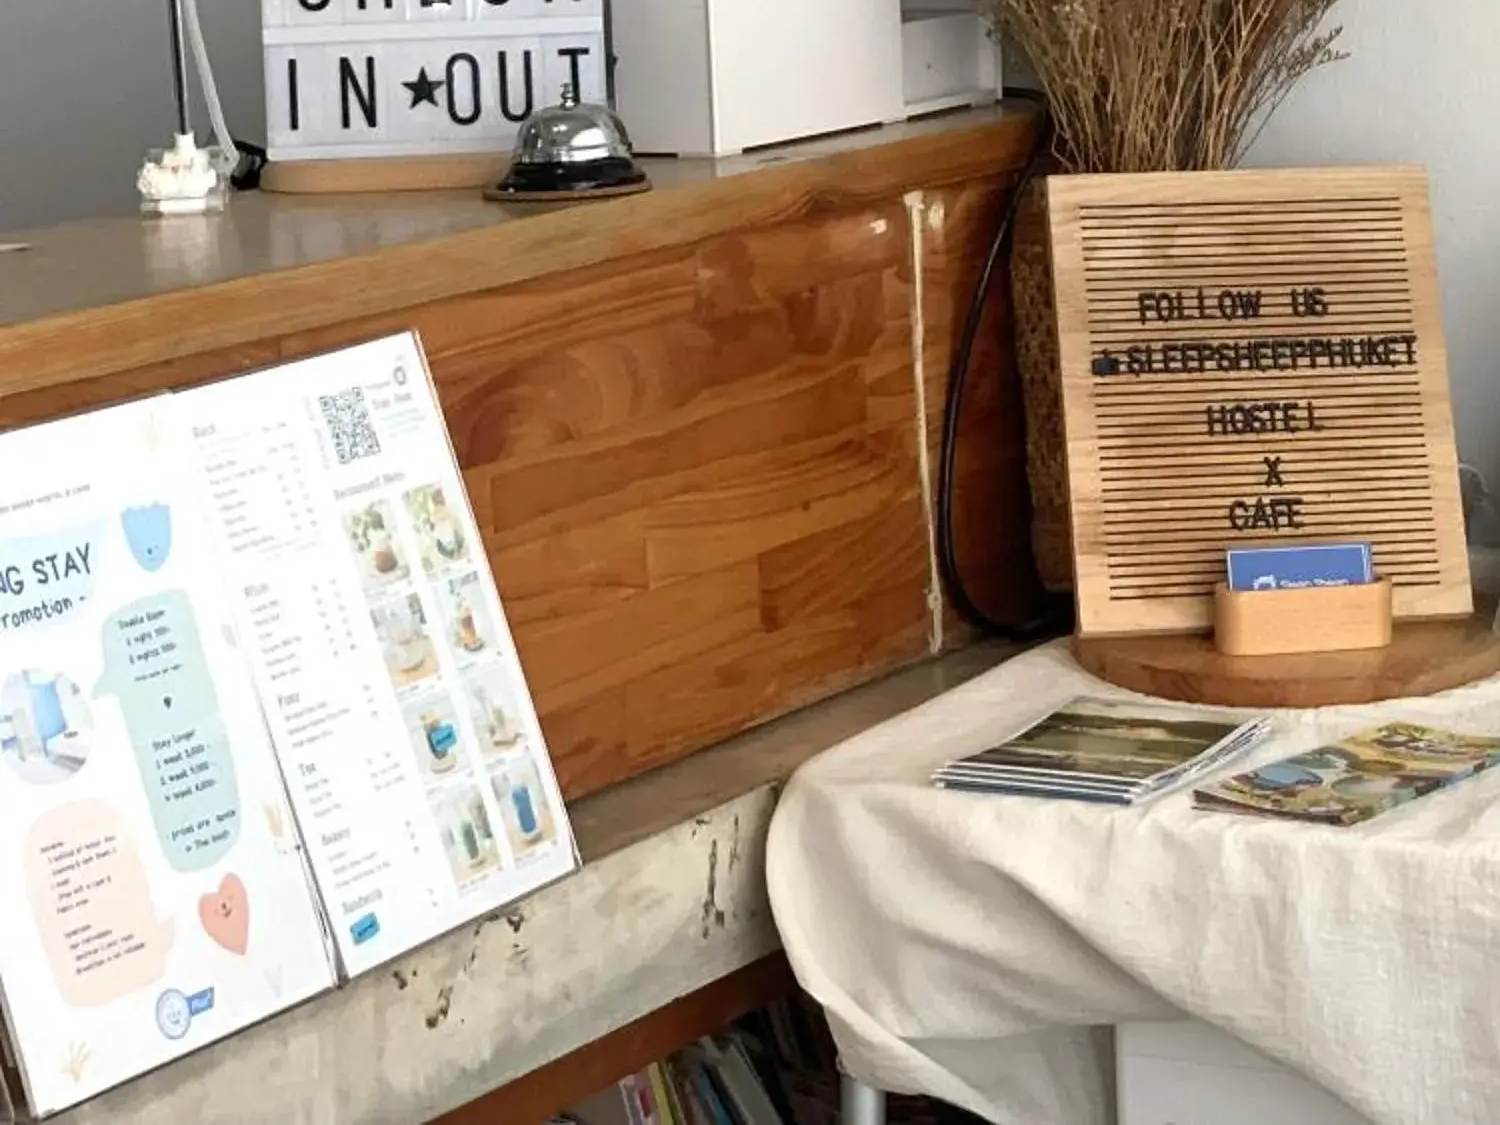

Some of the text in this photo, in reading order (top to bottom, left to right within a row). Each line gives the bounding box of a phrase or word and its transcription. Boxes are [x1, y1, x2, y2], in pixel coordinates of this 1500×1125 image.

[287, 46, 591, 131] IN OUT
[1137, 286, 1329, 324] FOLLOW US
[1127, 335, 1418, 377] SLEEPSHEEPPHUKET
[1207, 402, 1324, 437] HOSTEL
[1263, 456, 1284, 487] X
[1228, 499, 1305, 532] CAFE
[32, 542, 91, 584] STAY
[0, 597, 73, 629] romotion
